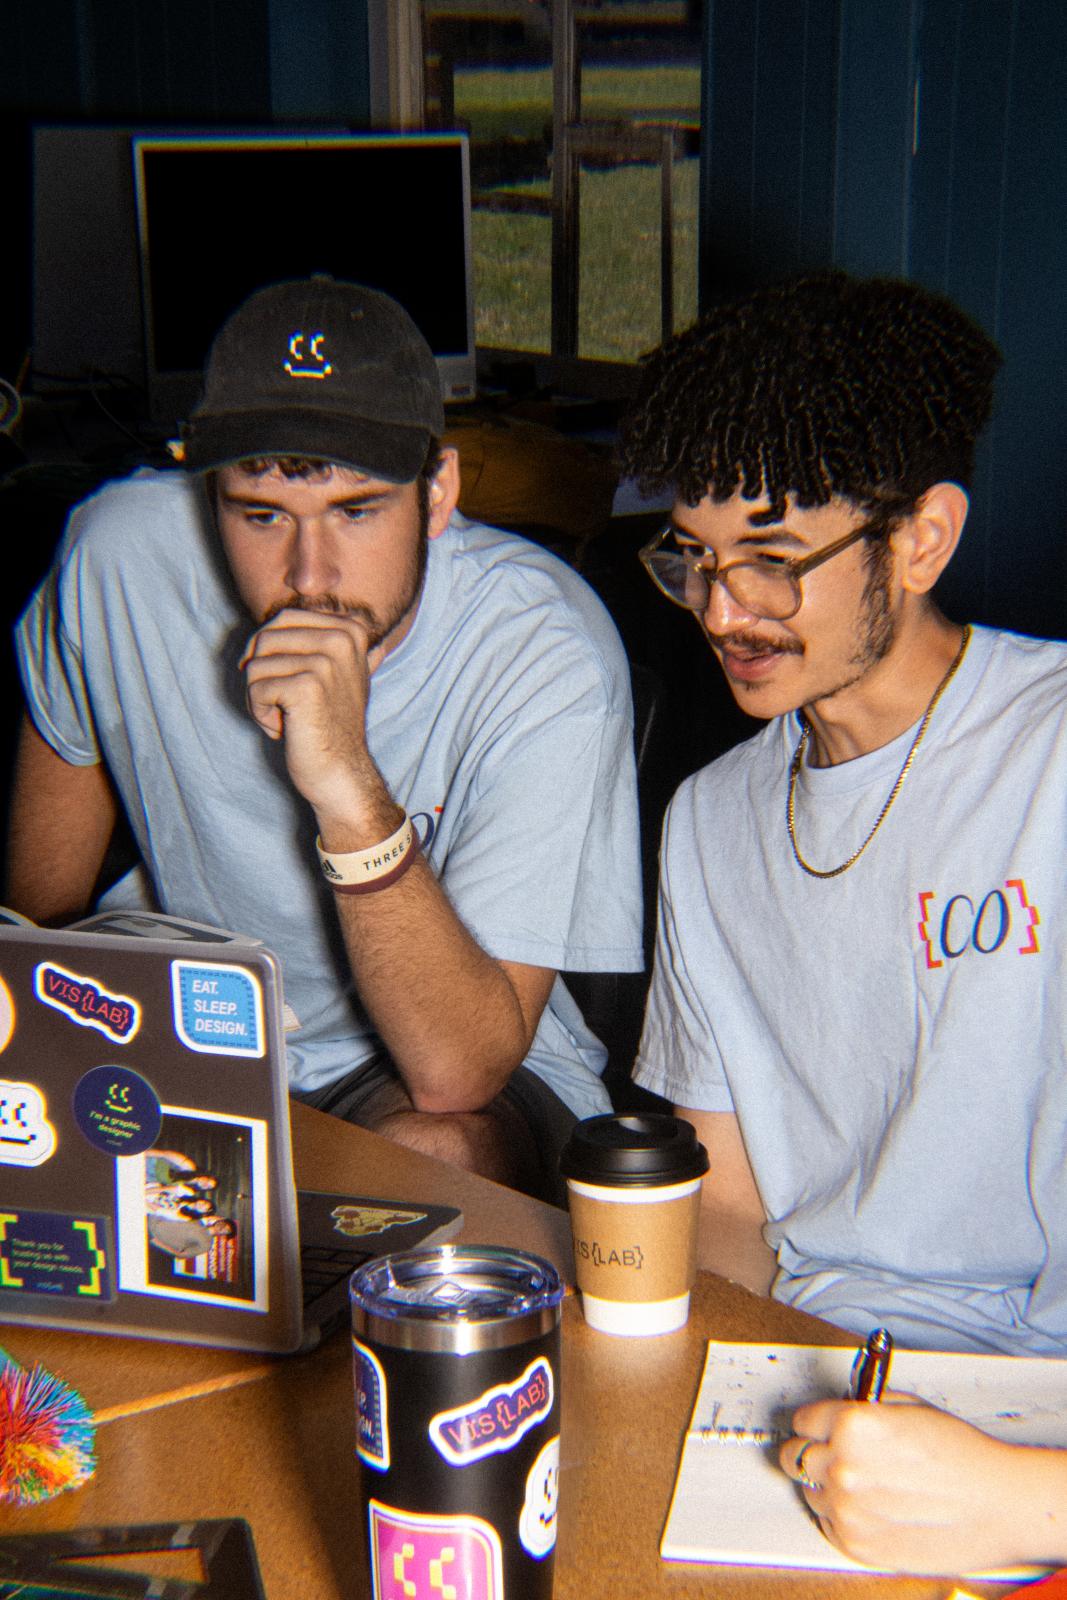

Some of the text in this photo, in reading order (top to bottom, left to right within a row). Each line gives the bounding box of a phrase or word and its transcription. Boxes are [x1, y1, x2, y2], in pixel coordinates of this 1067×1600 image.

[363, 842, 405, 871] THREE
[918, 879, 1040, 969] {CO}
[192, 979, 219, 995] EAT.
[49, 975, 129, 1030] VIS{LAB}
[193, 999, 238, 1016] SLEEP.
[195, 1018, 249, 1036] DESIGN.
[110, 1117, 142, 1132] graphic
[447, 1374, 546, 1445] VIS{LAB}
